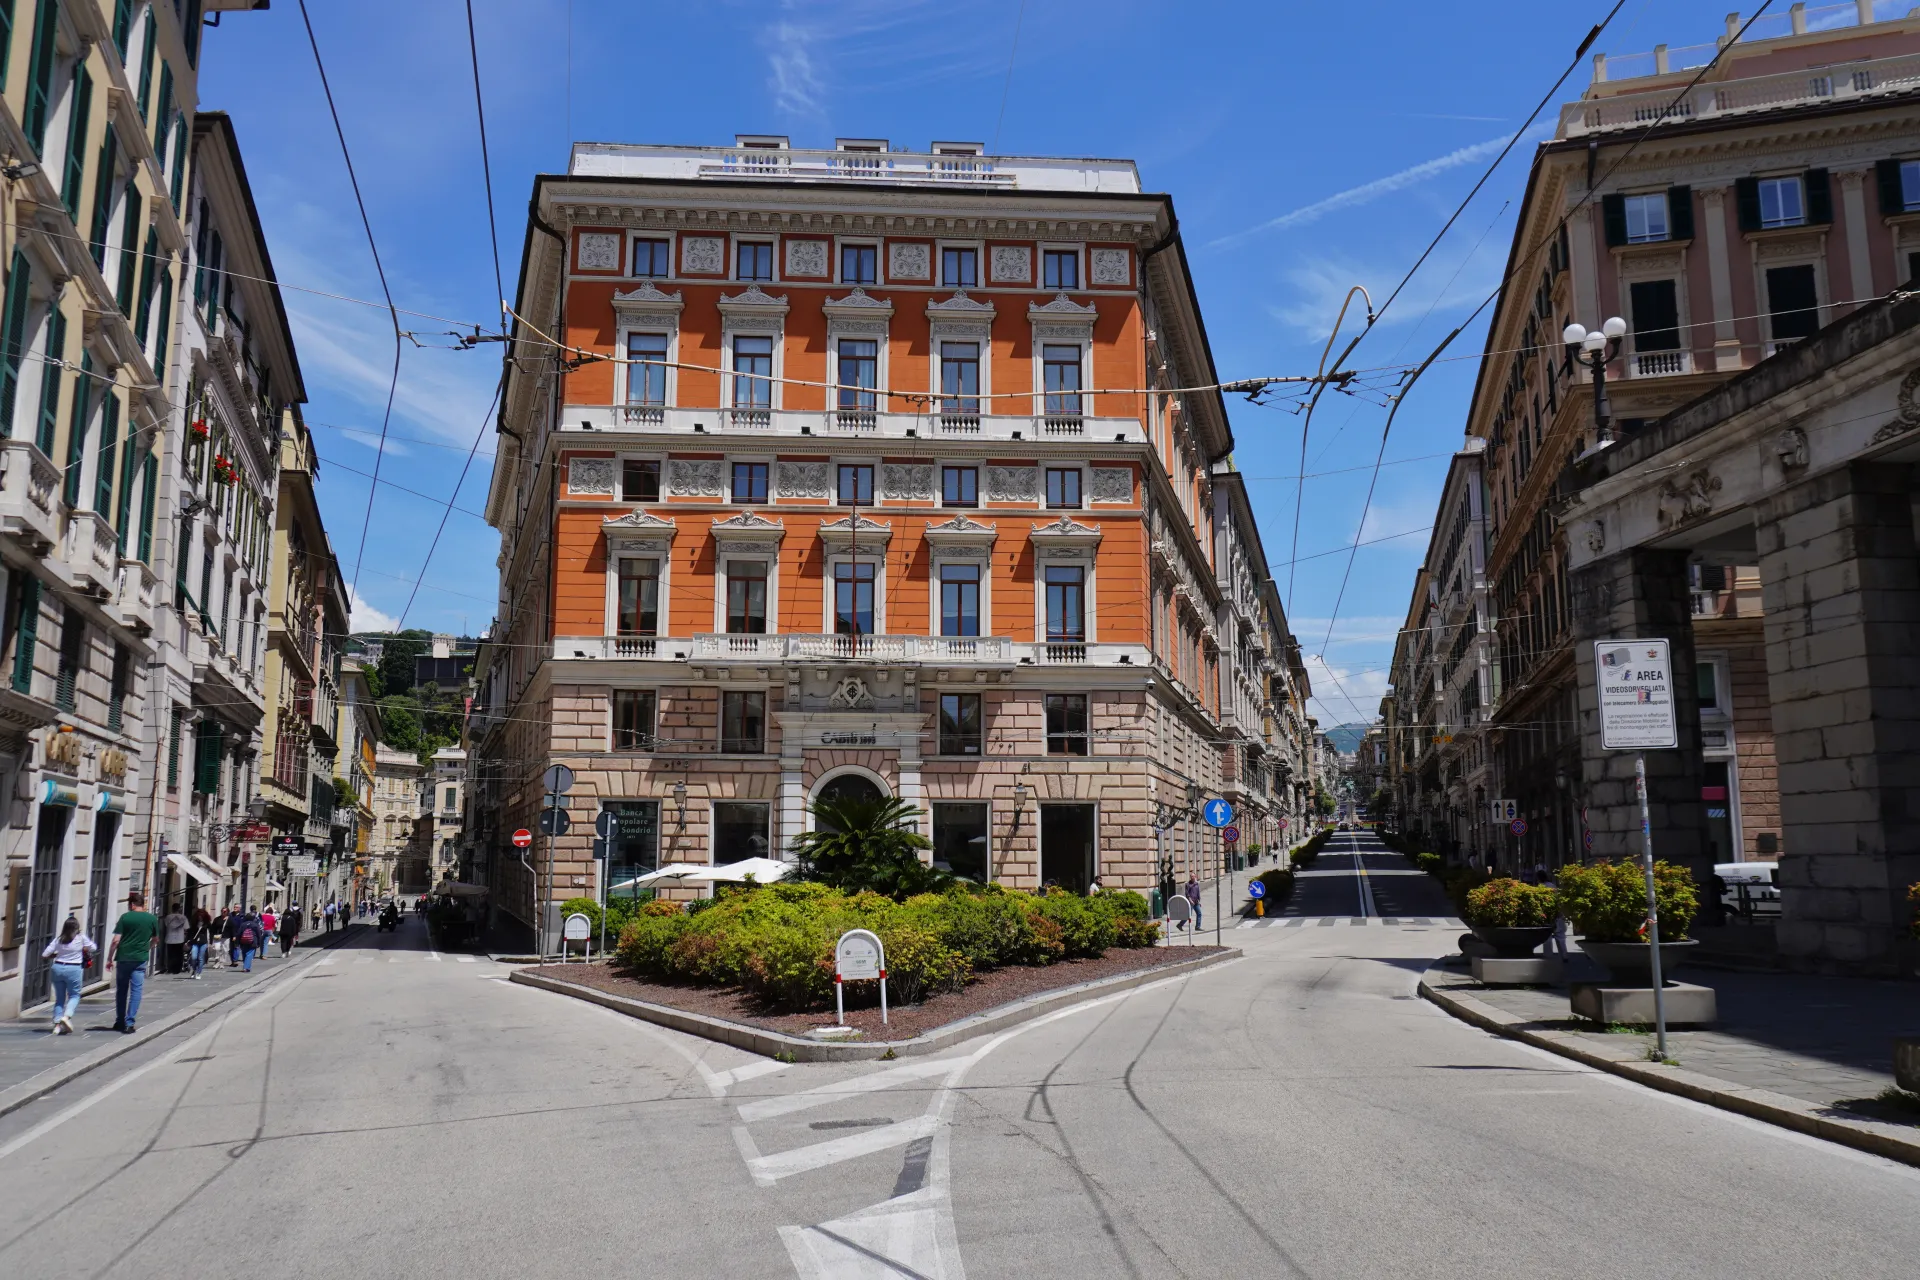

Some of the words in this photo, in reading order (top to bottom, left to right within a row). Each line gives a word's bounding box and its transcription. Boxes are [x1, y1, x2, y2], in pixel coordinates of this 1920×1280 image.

[1637, 670, 1664, 681] AREA
[1605, 685, 1666, 694] VIDEOSORVEGLIATA
[621, 826, 651, 834] Sondrio
